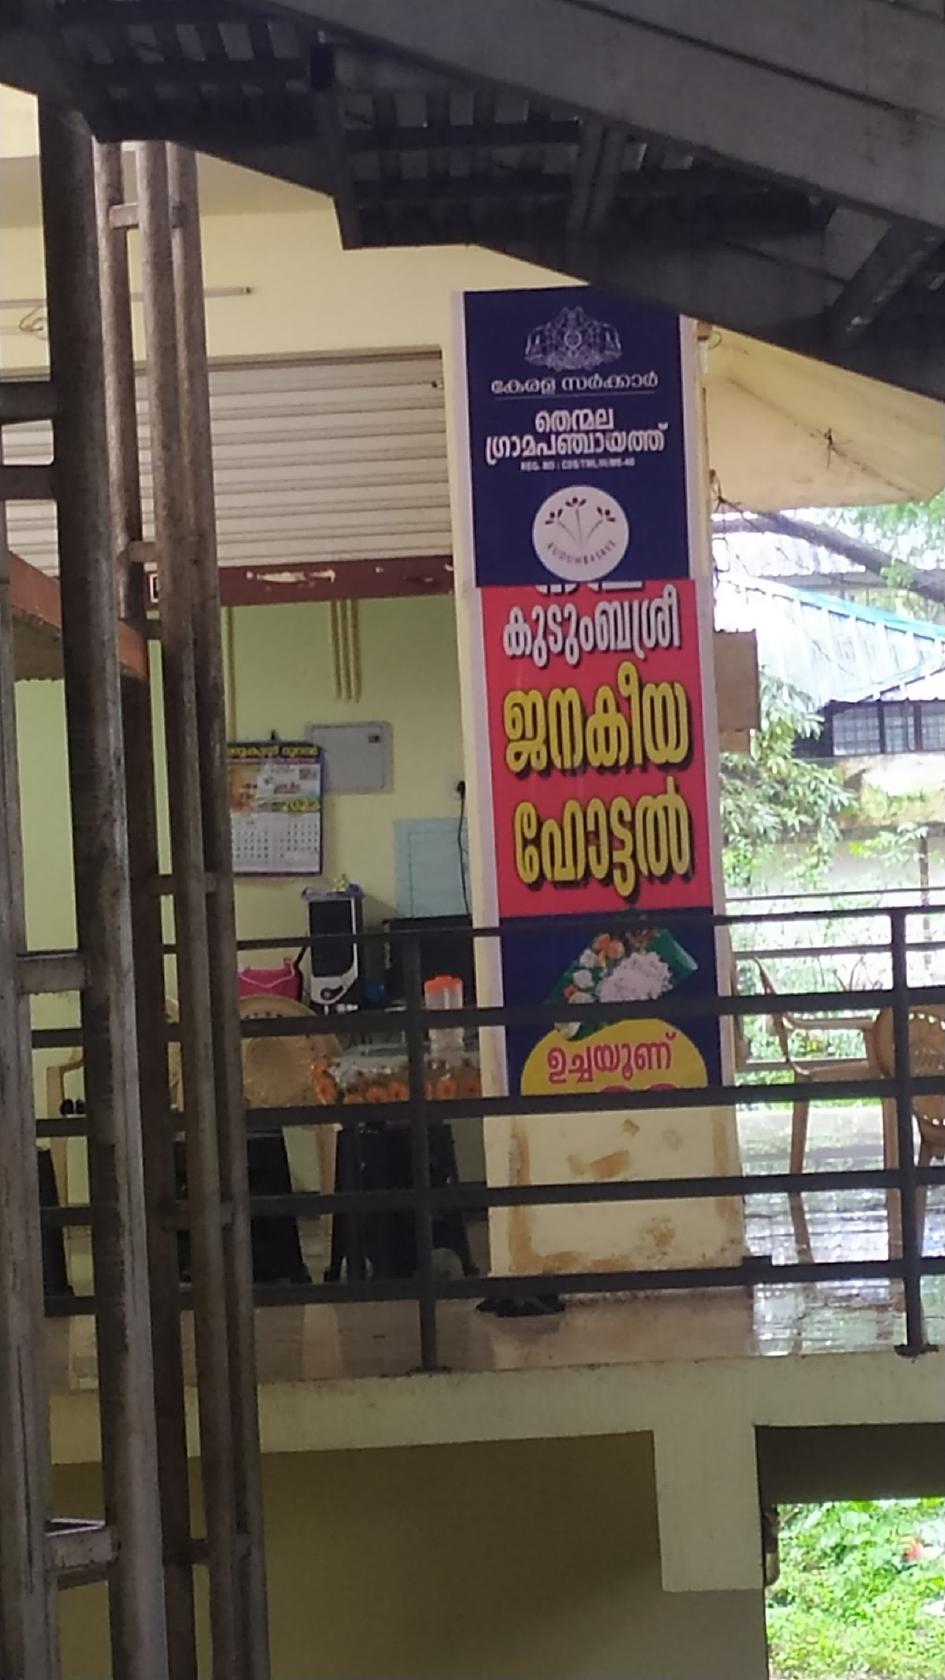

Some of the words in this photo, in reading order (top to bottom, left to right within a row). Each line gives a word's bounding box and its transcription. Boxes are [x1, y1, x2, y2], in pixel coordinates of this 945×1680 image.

[491, 378, 556, 395] കേരള
[561, 371, 658, 392] സർക്കാർ
[534, 408, 615, 433] തെന്മല
[486, 422, 668, 465] ഗ്രാമപഞ്ചായത്ത്
[503, 661, 689, 772] ജനകീയ
[514, 775, 691, 897] ഹോട്ടൽ
